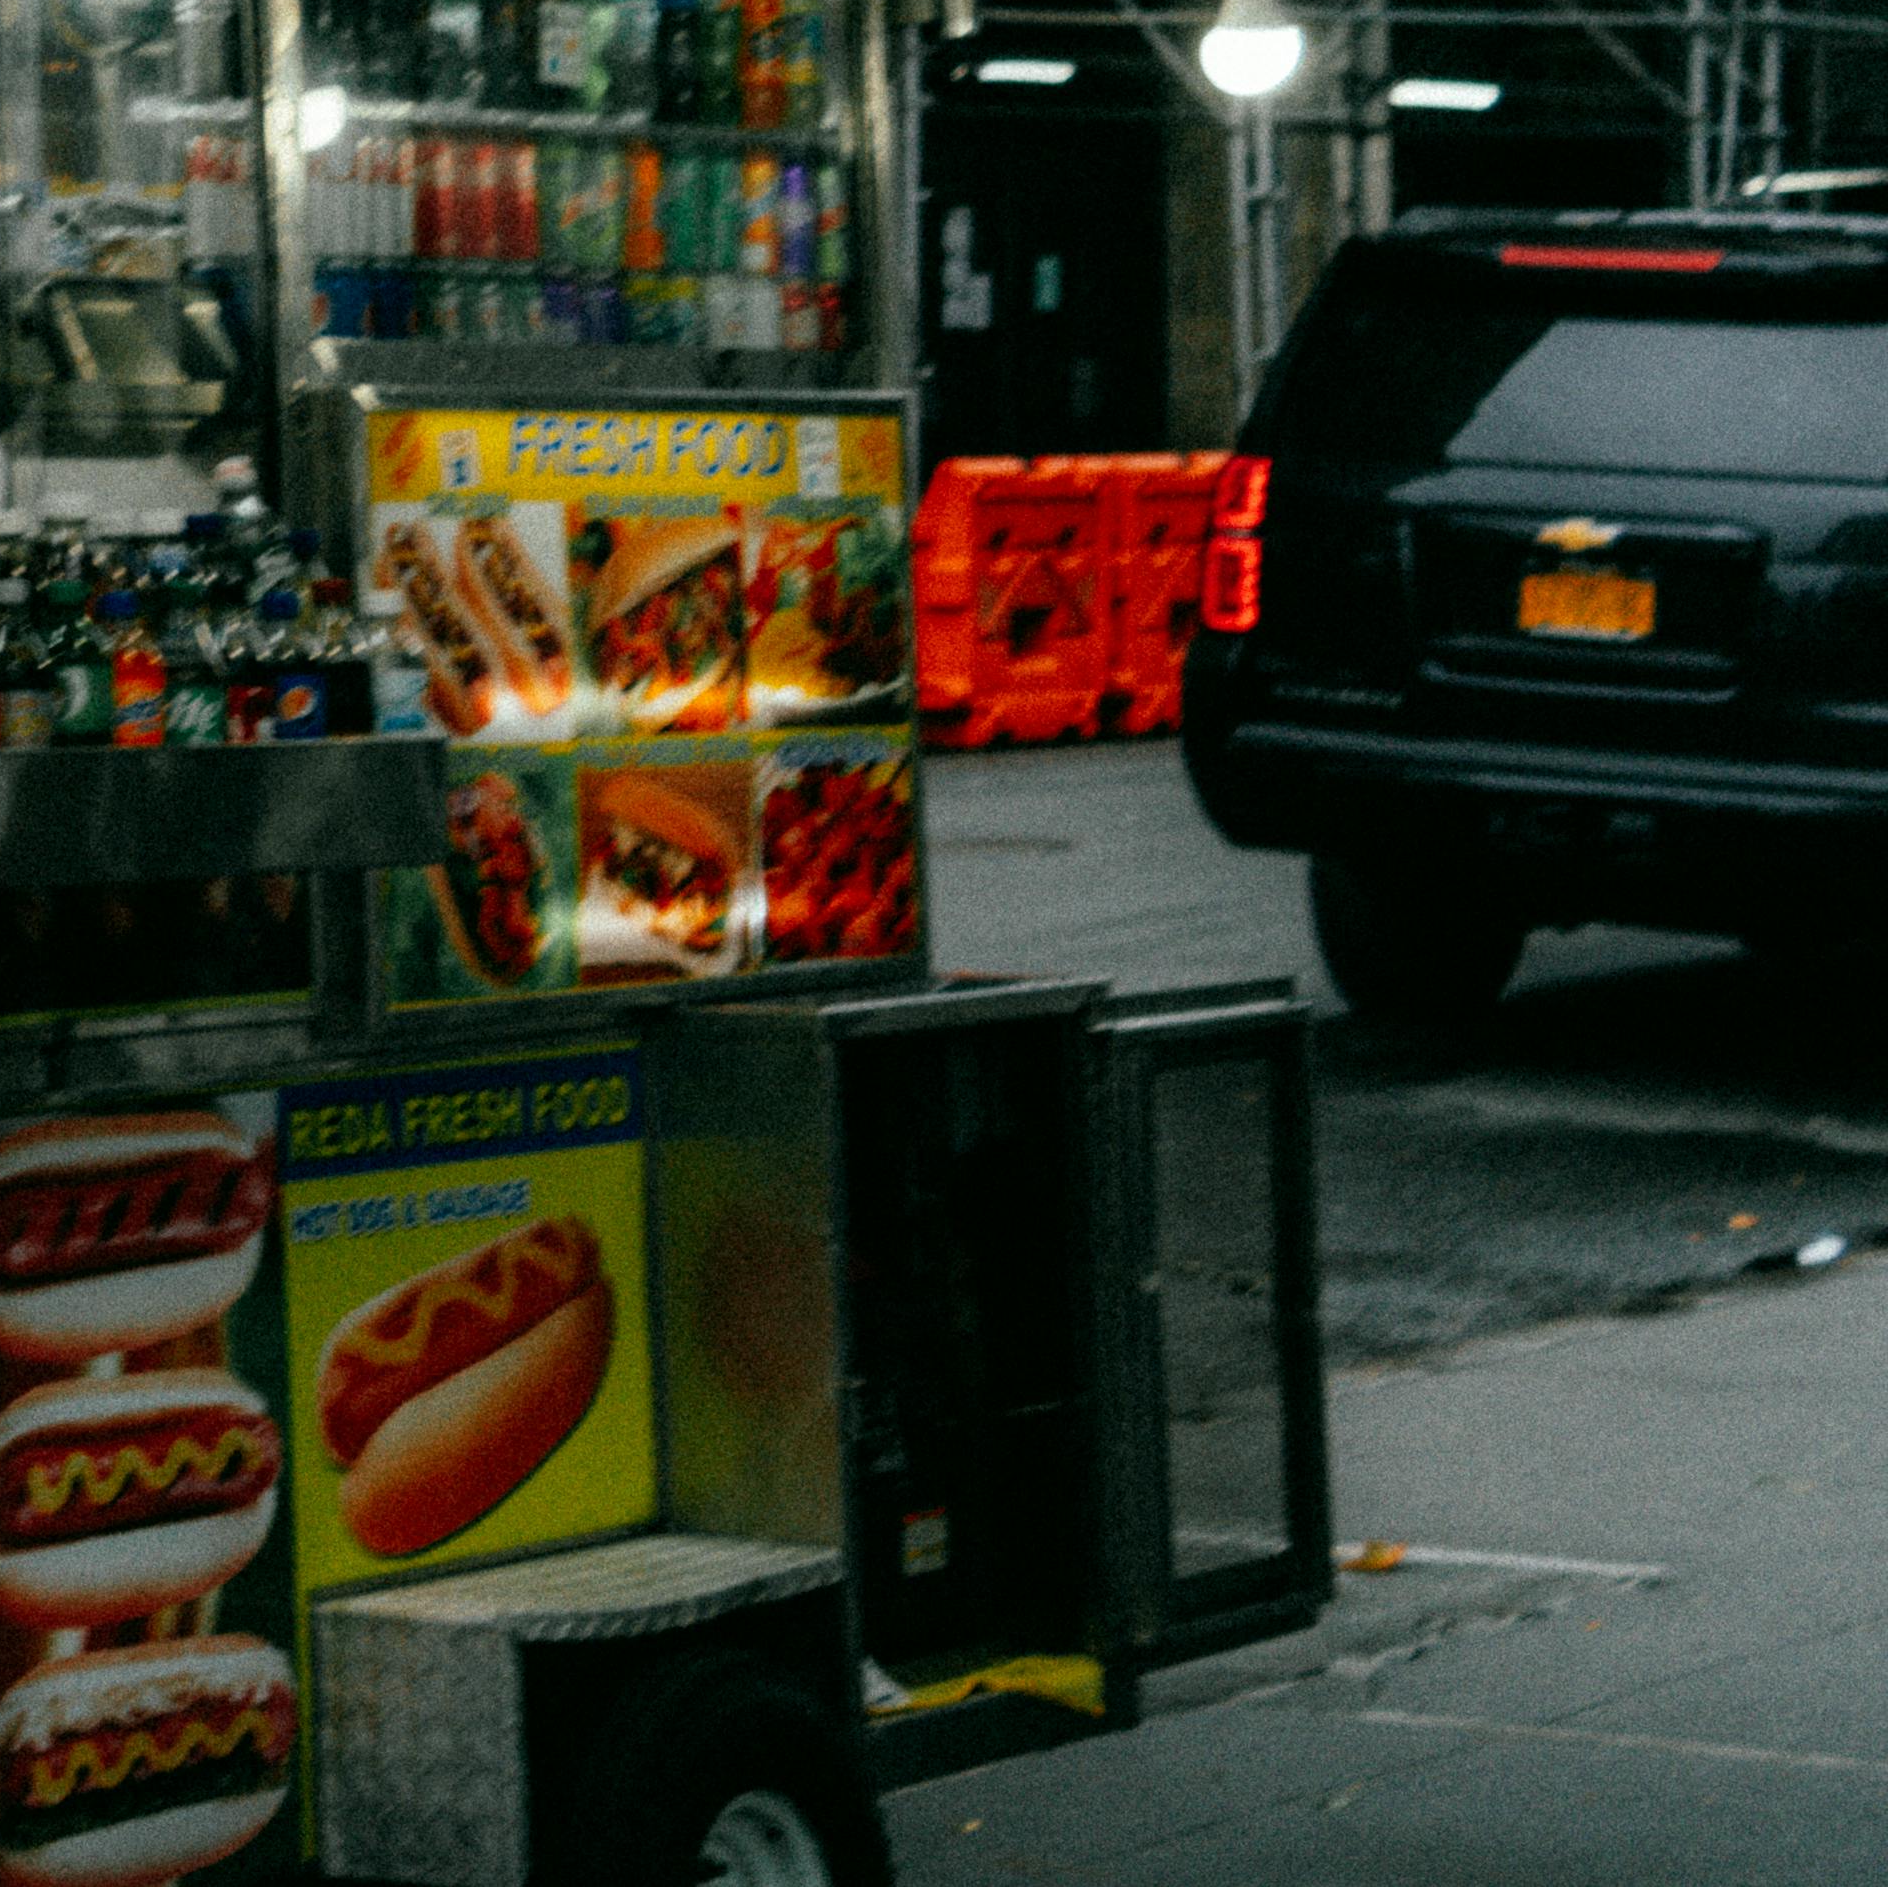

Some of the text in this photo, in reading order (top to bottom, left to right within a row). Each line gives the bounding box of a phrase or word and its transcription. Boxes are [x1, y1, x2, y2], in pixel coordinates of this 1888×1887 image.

[508, 412, 660, 478] FRESH
[667, 416, 790, 478] FOOD
[403, 1083, 524, 1150] FRESH
[529, 1073, 632, 1136] FOOD
